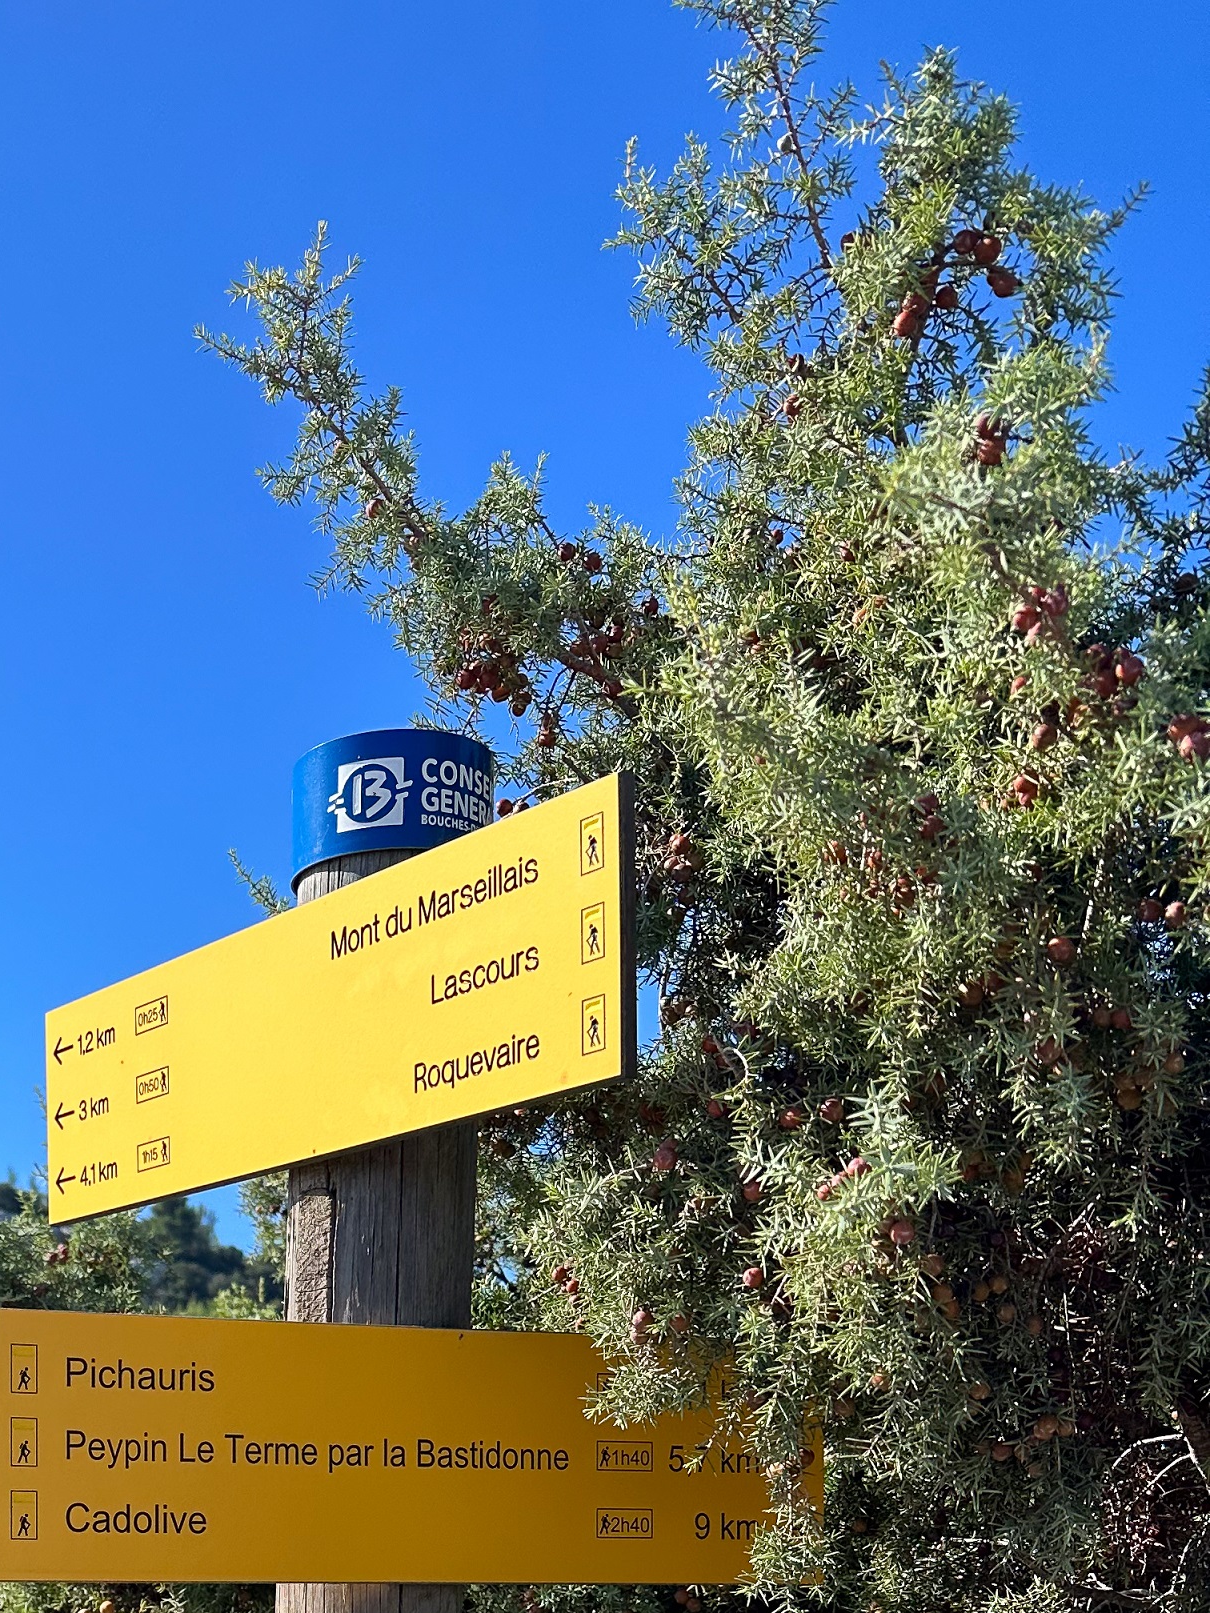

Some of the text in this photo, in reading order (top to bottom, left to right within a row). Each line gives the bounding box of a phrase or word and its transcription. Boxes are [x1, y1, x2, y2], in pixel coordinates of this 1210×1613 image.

[330, 857, 540, 961] Mont du Marseillais
[430, 945, 540, 1005] Lascours
[137, 1006, 159, 1028] 0h25
[96, 1026, 116, 1050] km
[414, 1034, 540, 1094] Roquevaire
[138, 1076, 160, 1097] 0h50
[78, 1096, 110, 1121] 3 km
[141, 1147, 159, 1165] 1h15
[98, 1161, 118, 1183] km
[65, 1356, 215, 1393] Pichauris
[65, 1430, 570, 1473] Peypin Le Terme par la Bastidonne
[611, 1448, 650, 1467] 1h40
[720, 1446, 760, 1474] km
[65, 1502, 208, 1535] Cadolive
[610, 1516, 651, 1535] 2h40
[694, 1512, 760, 1540] 9 km
